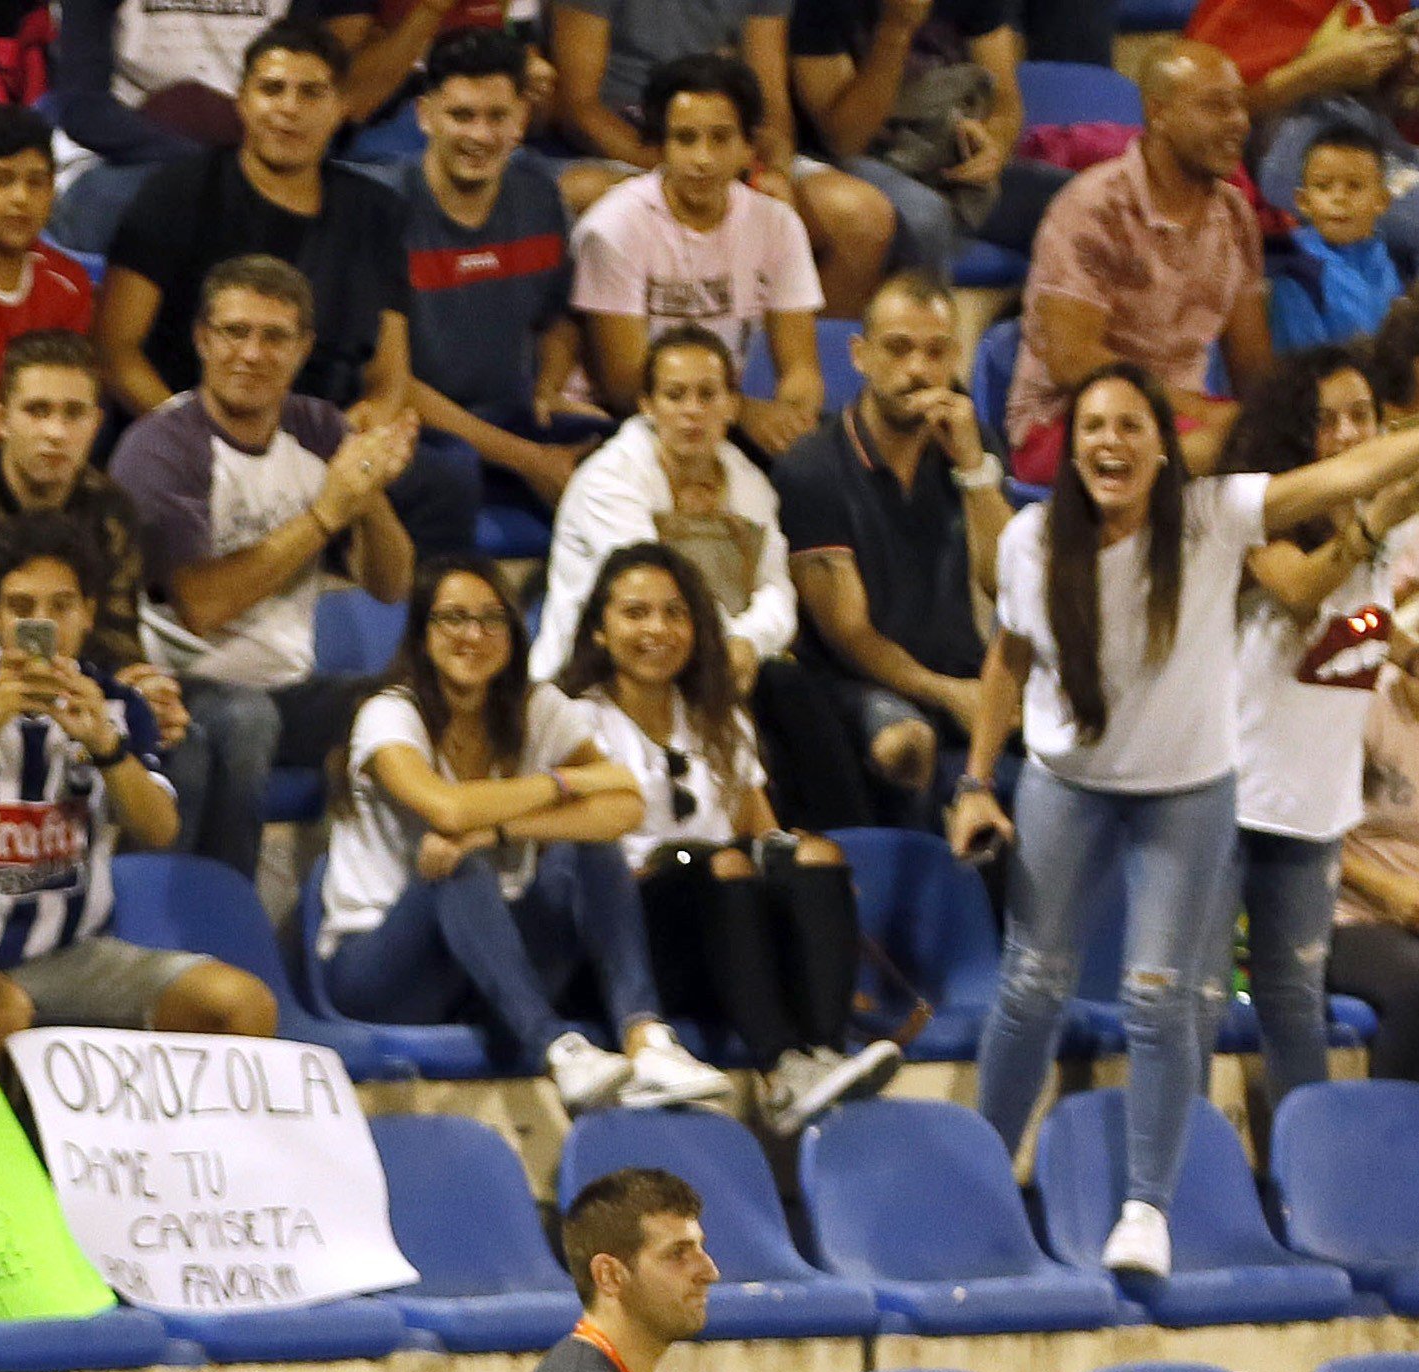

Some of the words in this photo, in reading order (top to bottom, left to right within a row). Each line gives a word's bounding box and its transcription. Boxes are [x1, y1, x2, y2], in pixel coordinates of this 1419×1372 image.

[43, 1041, 340, 1120] ODRIOZOLA
[64, 1139, 158, 1199] DAME
[171, 1150, 227, 1199] TU
[130, 1206, 325, 1250] CAMISETA
